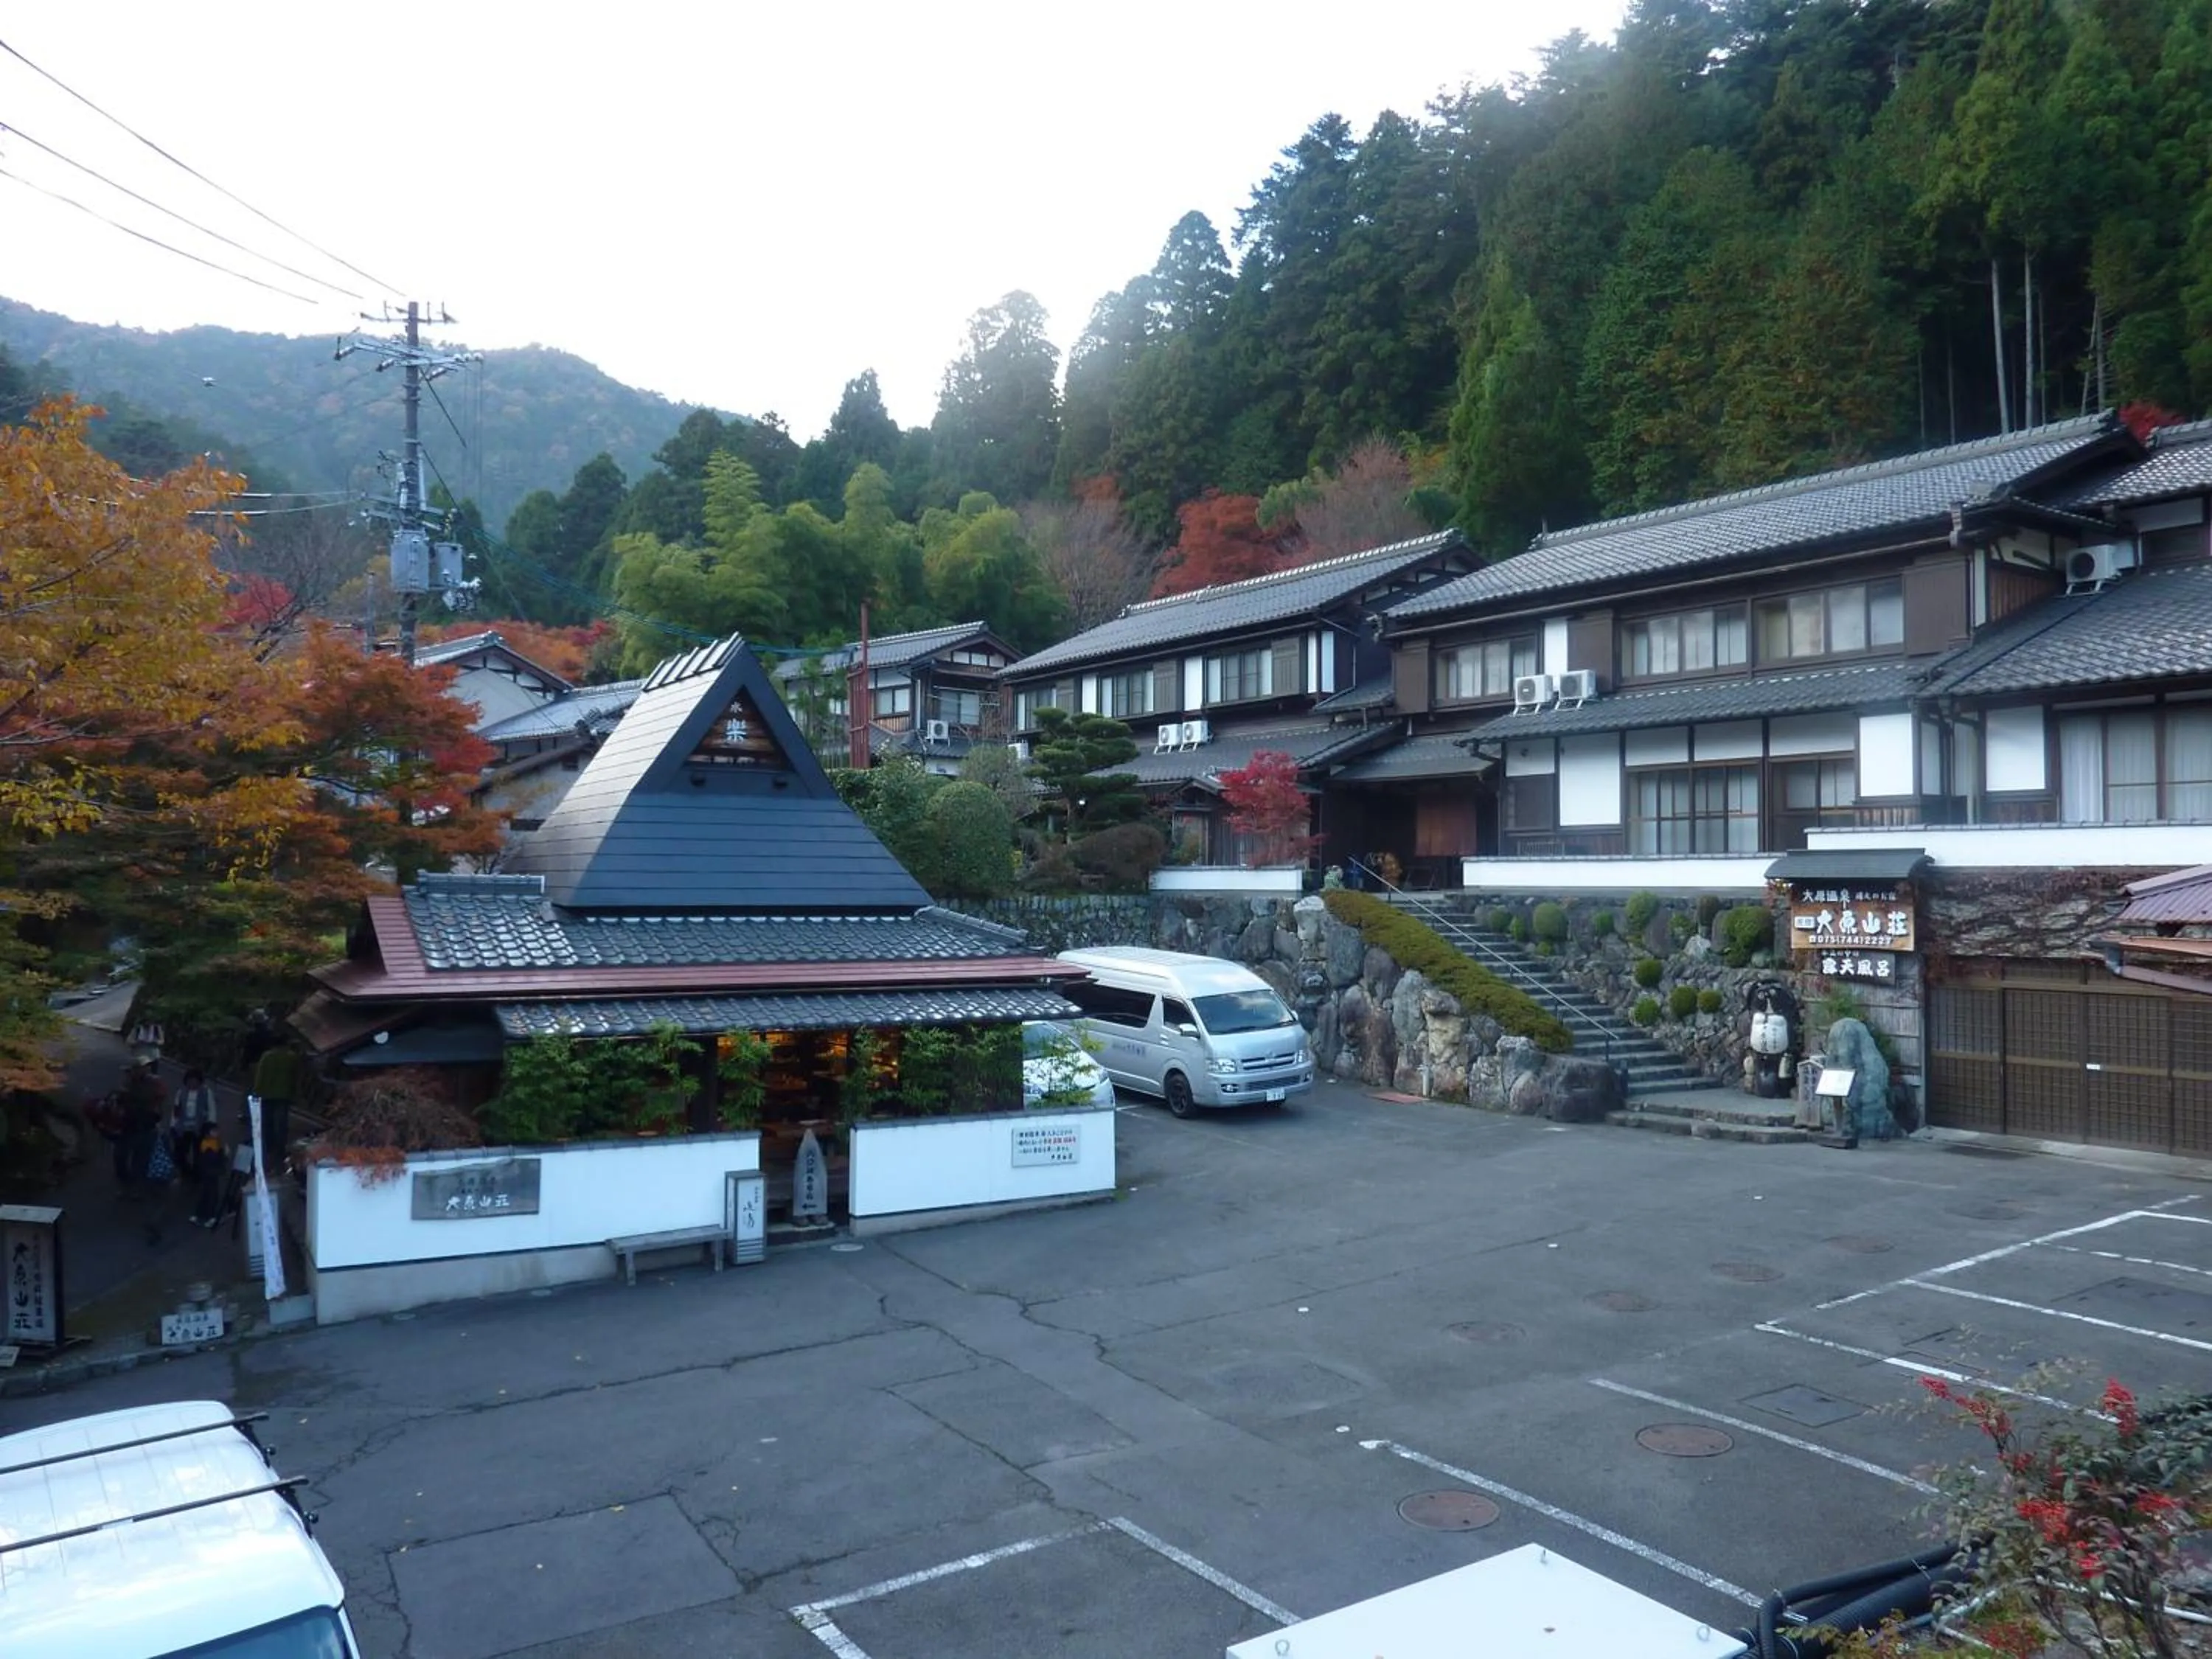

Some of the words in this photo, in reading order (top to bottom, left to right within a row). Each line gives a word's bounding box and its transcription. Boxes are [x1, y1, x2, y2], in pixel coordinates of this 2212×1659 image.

[730, 701, 742, 713] 水
[1802, 888, 1851, 908] 大原温泉
[1816, 909, 1908, 936] 大原山荘
[1821, 957, 1891, 978] 露天風呂
[445, 1194, 511, 1211] 大原山荘
[13, 1242, 32, 1329] 大原山荘
